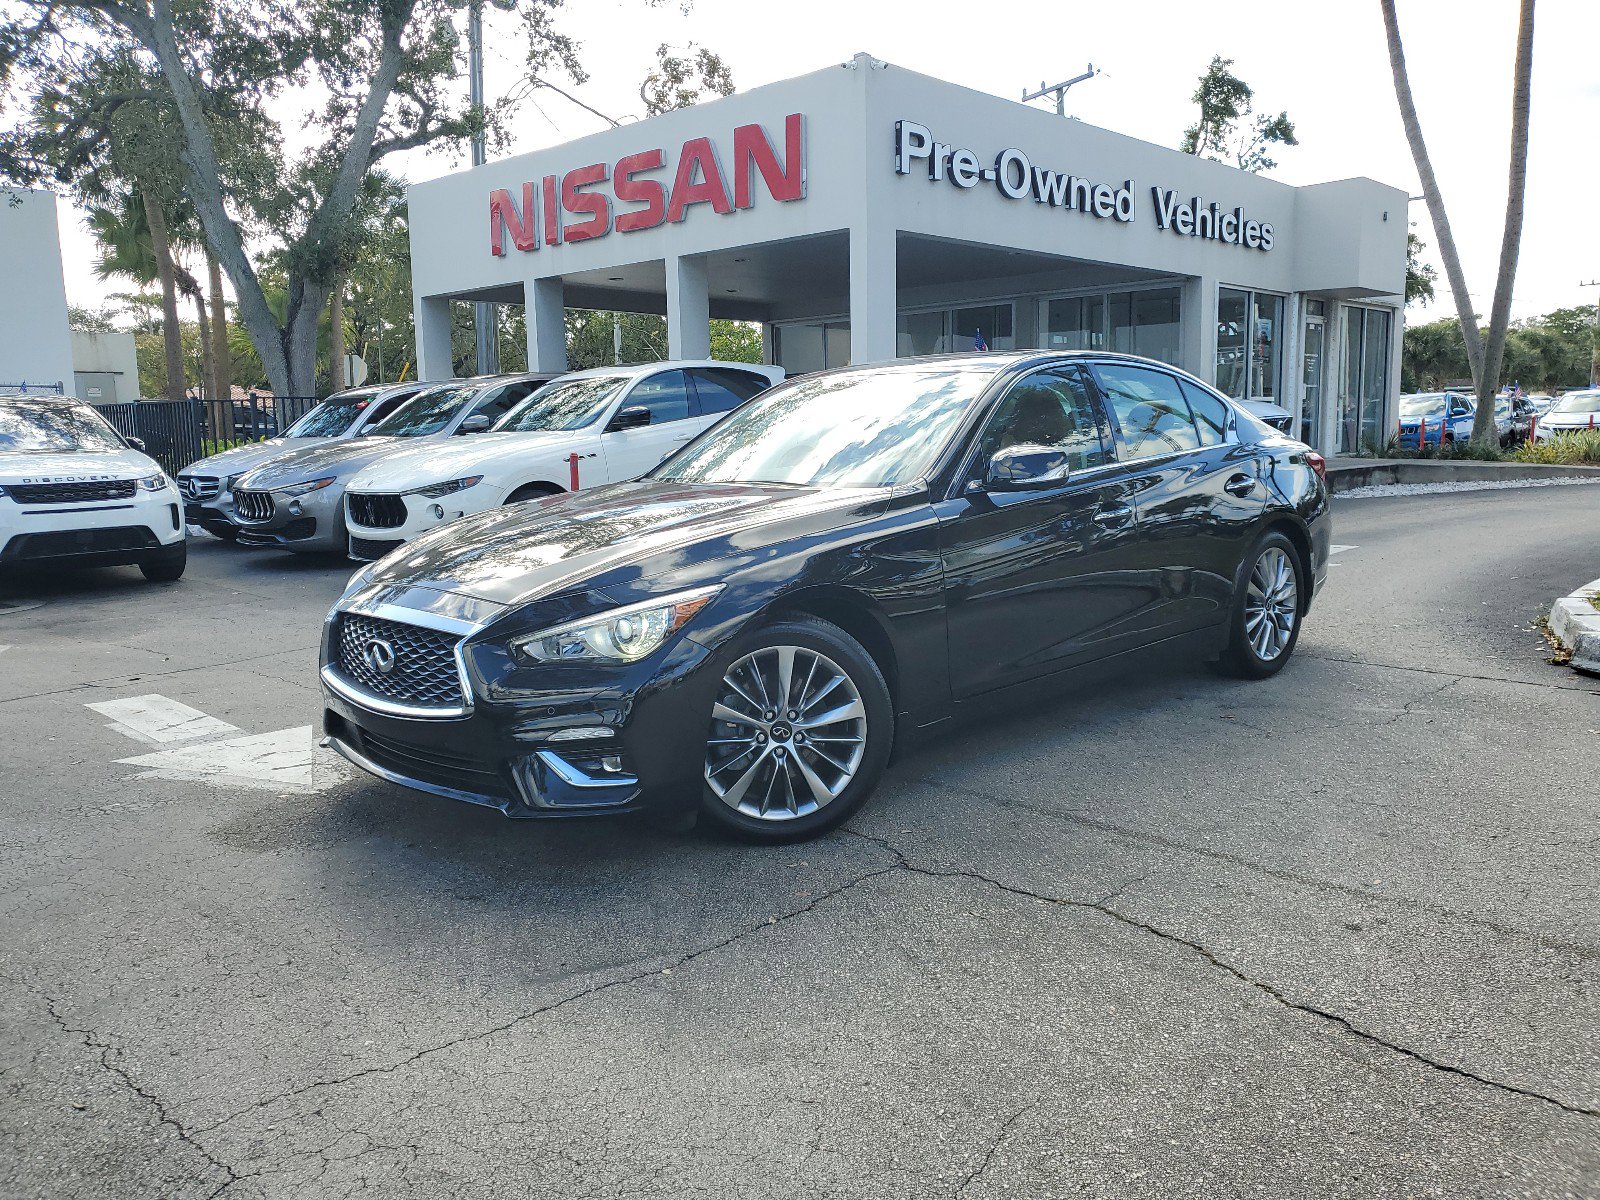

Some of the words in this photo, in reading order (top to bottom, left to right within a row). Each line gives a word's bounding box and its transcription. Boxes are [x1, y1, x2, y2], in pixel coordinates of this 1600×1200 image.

[490, 112, 805, 257] NISSAN
[896, 119, 1135, 223] Pre-Owned
[1151, 185, 1274, 251] Vehicles
[22, 474, 120, 484] DISCOVERY
